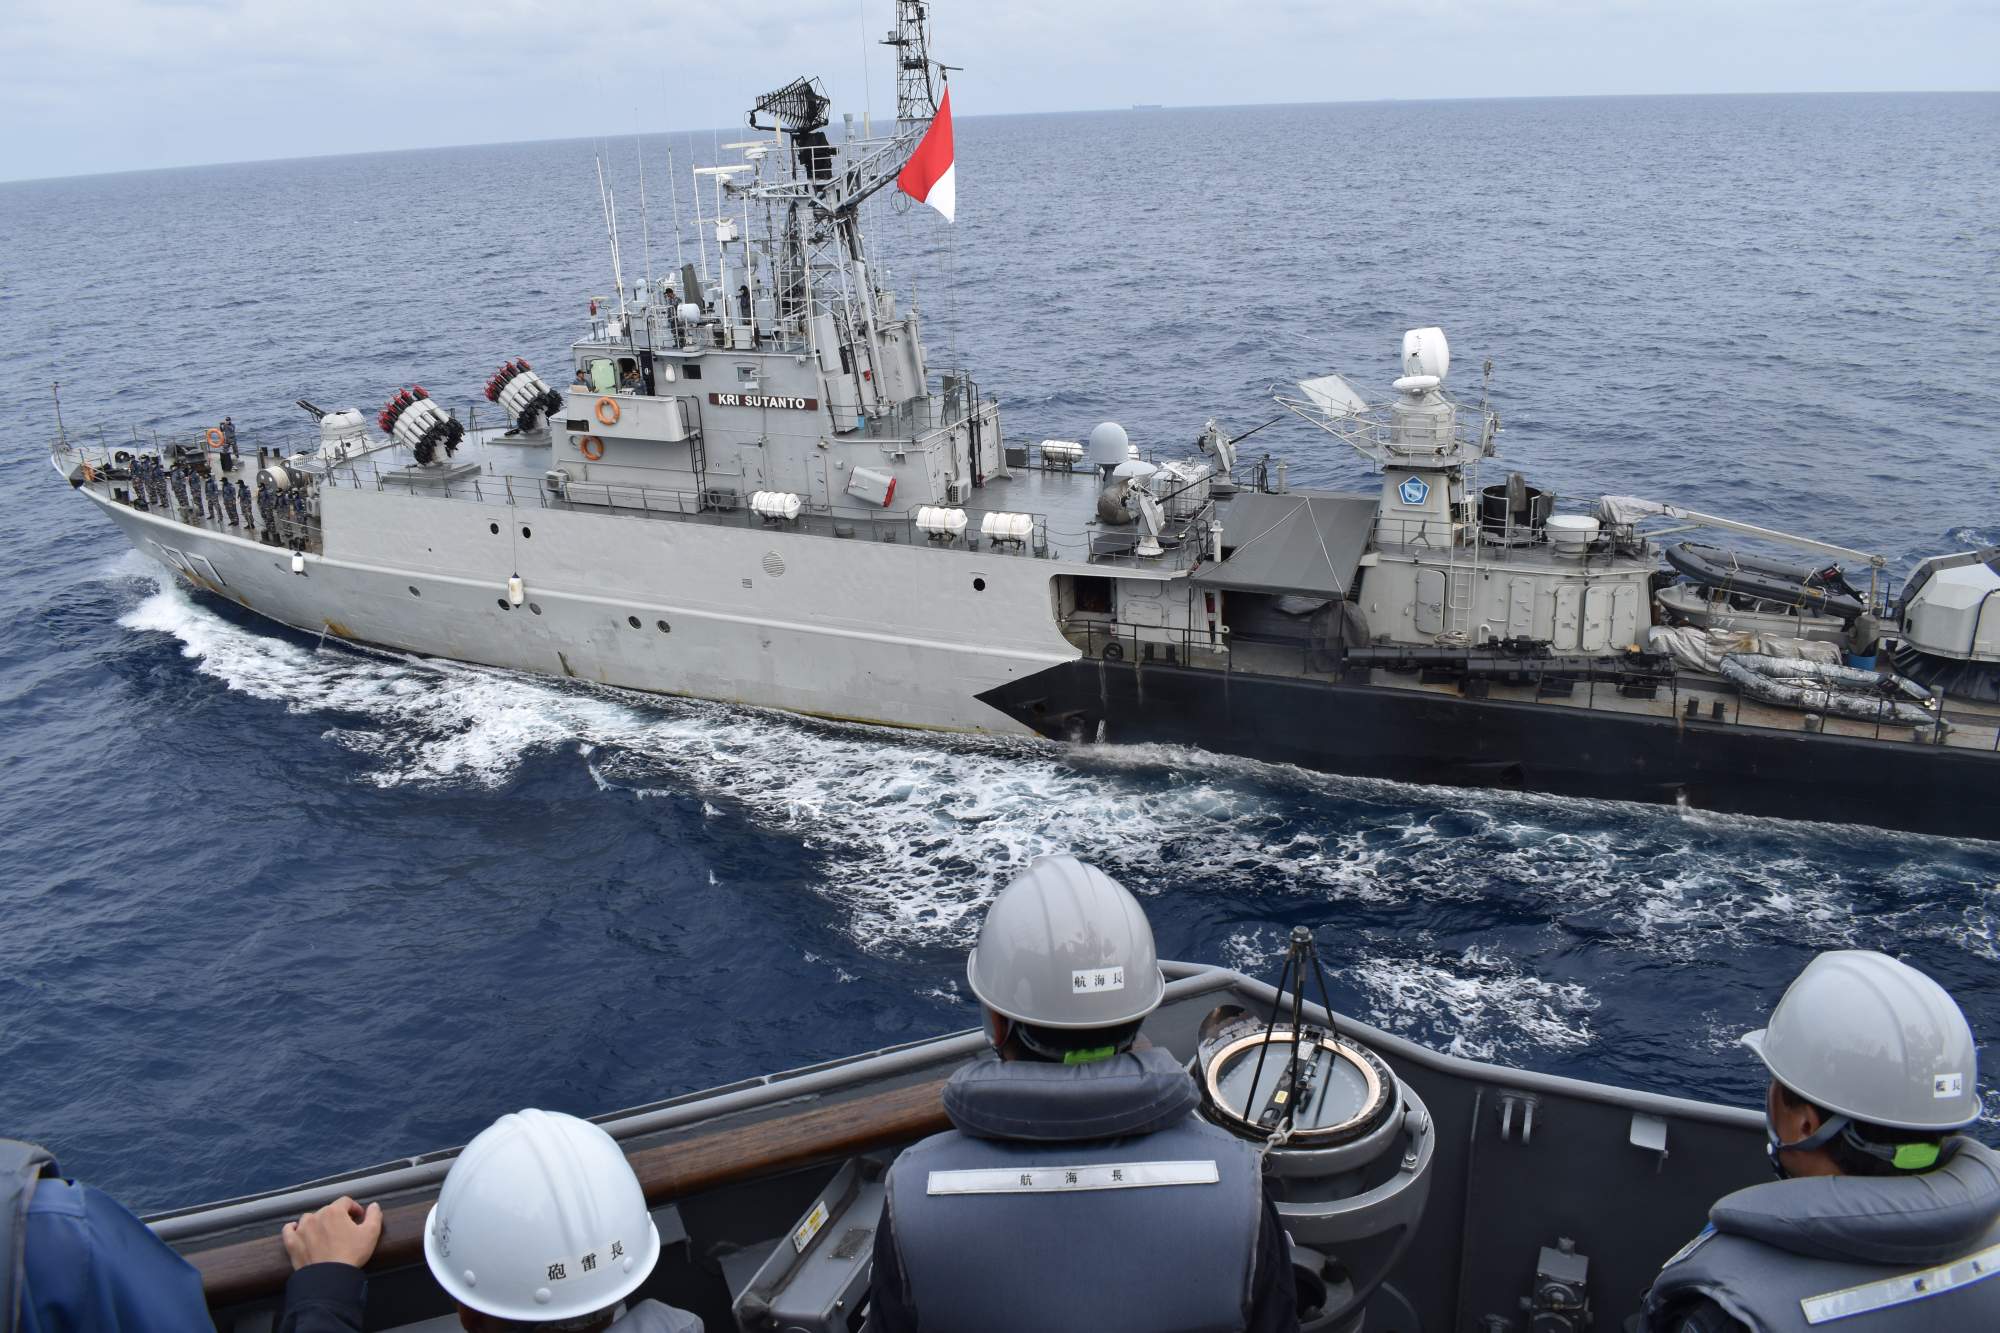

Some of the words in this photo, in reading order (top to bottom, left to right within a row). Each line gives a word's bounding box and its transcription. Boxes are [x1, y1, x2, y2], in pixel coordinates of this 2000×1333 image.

[718, 393, 739, 405] KRI
[745, 395, 805, 409] SUTANTO
[1074, 971, 1123, 988] 航海長
[1020, 1169, 1124, 1187] 航海長
[547, 1240, 624, 1281] 砲雷長
